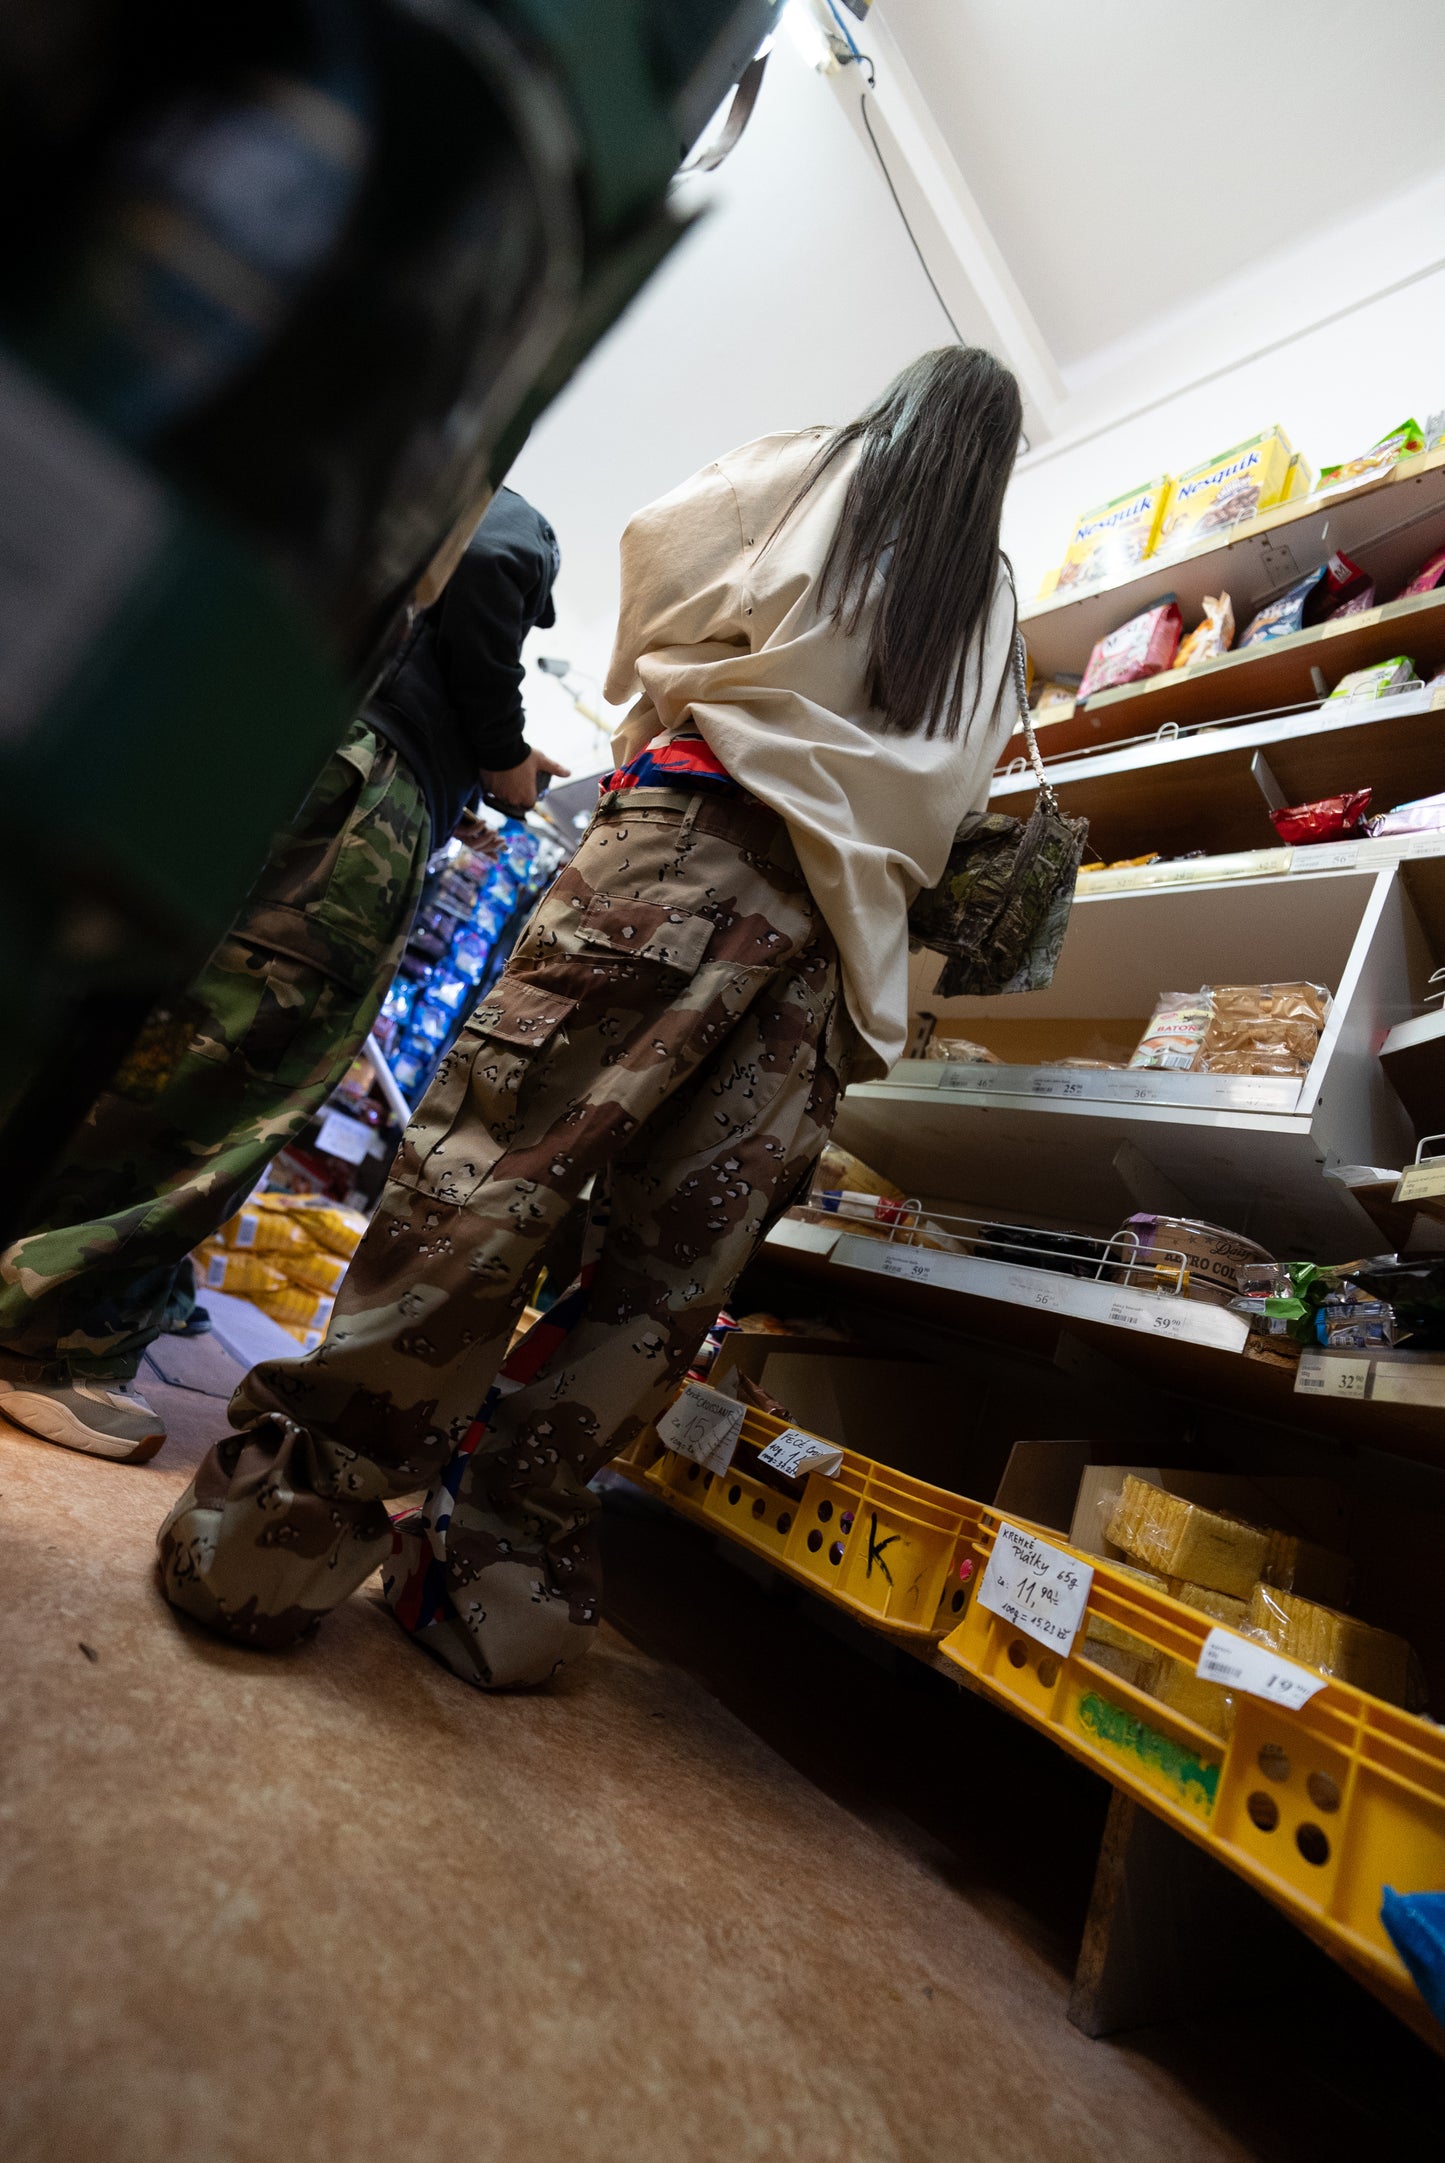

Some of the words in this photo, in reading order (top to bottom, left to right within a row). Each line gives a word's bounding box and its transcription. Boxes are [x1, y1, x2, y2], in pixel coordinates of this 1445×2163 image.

[1178, 452, 1260, 500] Nesquik
[1075, 496, 1152, 542] Nesquik
[1213, 1261, 1238, 1281] COL
[1153, 1316, 1171, 1329] 59
[1338, 1374, 1355, 1389] 32
[866, 1511, 901, 1587] K
[1056, 1570, 1080, 1590] 65g
